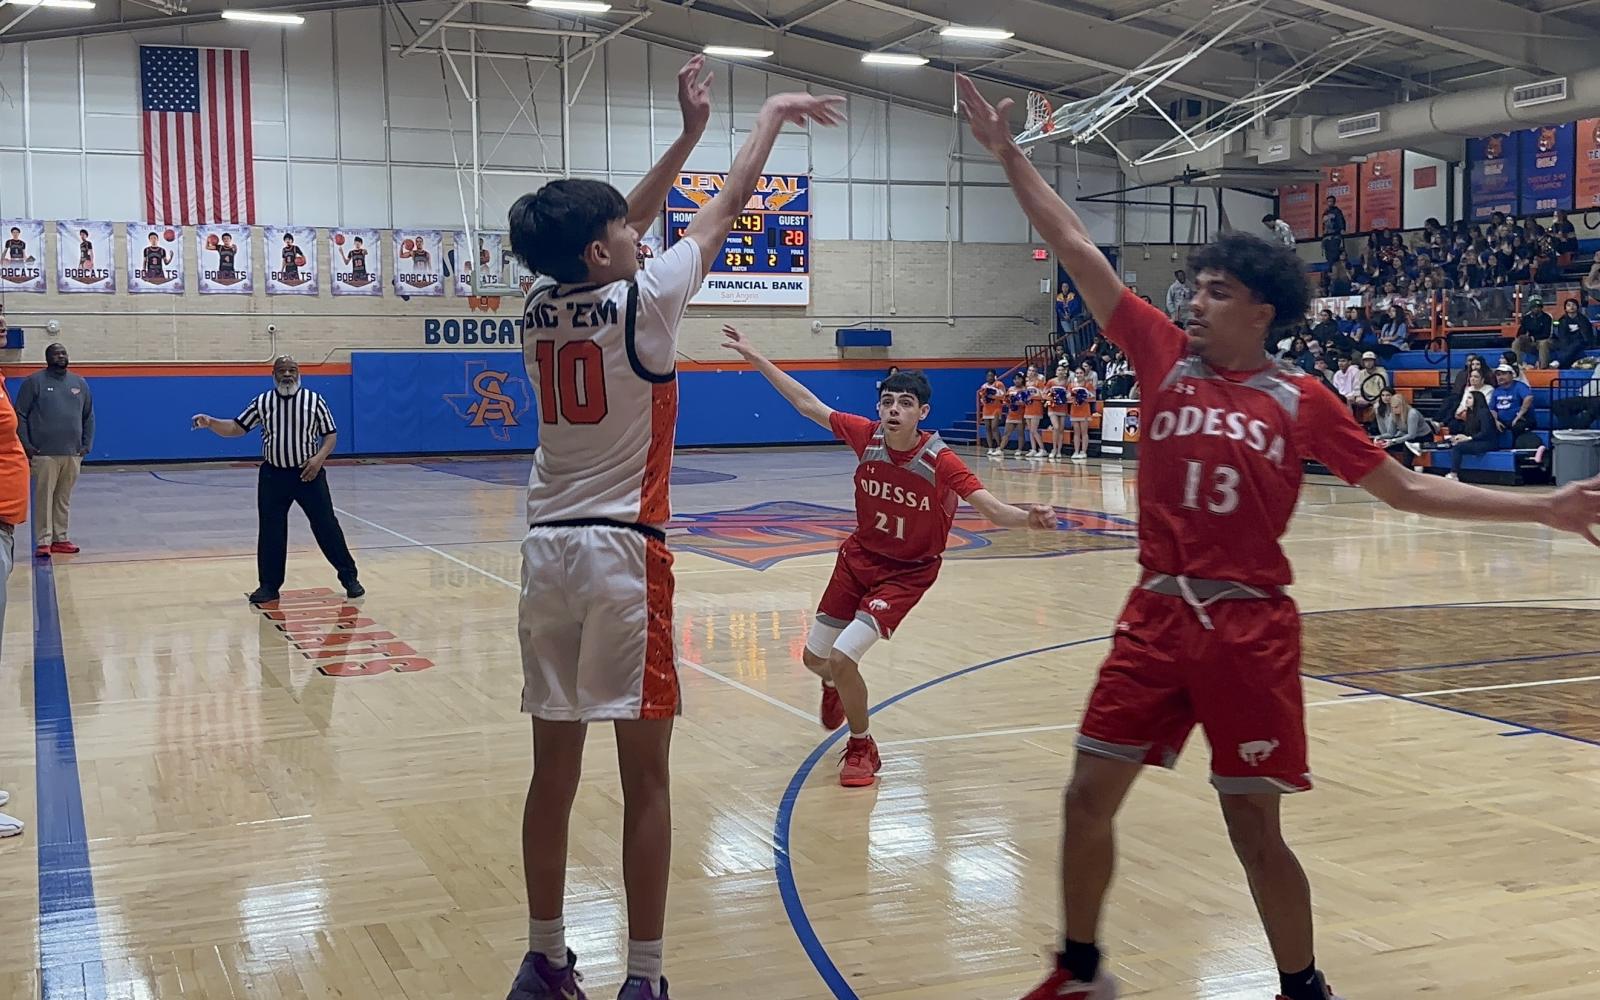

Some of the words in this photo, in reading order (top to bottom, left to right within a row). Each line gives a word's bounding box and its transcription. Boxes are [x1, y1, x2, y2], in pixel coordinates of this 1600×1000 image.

[673, 173, 798, 193] CENRAL
[779, 216, 805, 225] GUEST
[744, 236, 752, 245] 4
[785, 231, 804, 245] 28
[726, 254, 741, 265] 23
[746, 255, 753, 264] 4
[768, 255, 777, 266] 2
[1, 268, 40, 278] OBCATS
[64, 268, 109, 278] BOBCATS
[400, 274, 438, 282] BOBCATS
[708, 281, 768, 290] FINANCIAL
[772, 282, 803, 290] BANK
[535, 340, 608, 424] 10
[1150, 405, 1286, 465] ODESSA
[1181, 458, 1241, 514] 13
[860, 478, 930, 511] ODESSA
[874, 511, 905, 540] 21
